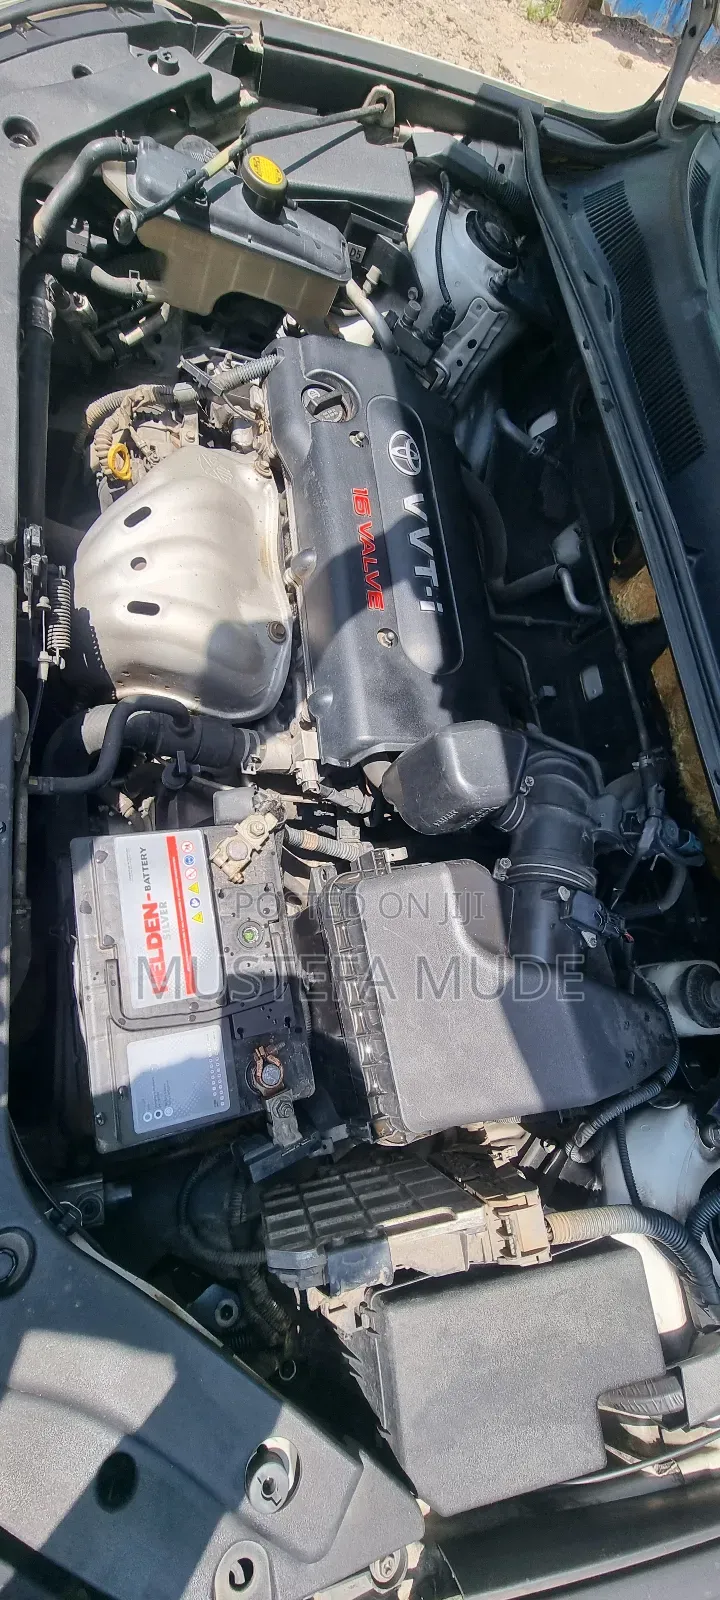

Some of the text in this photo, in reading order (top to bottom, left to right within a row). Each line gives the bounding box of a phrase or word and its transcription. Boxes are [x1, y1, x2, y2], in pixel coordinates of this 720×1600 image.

[352, 487, 385, 611] 16 VALVE
[403, 493, 443, 612] VVT-i
[139, 847, 152, 891] BATTERY
[159, 901, 171, 940] SILVER
